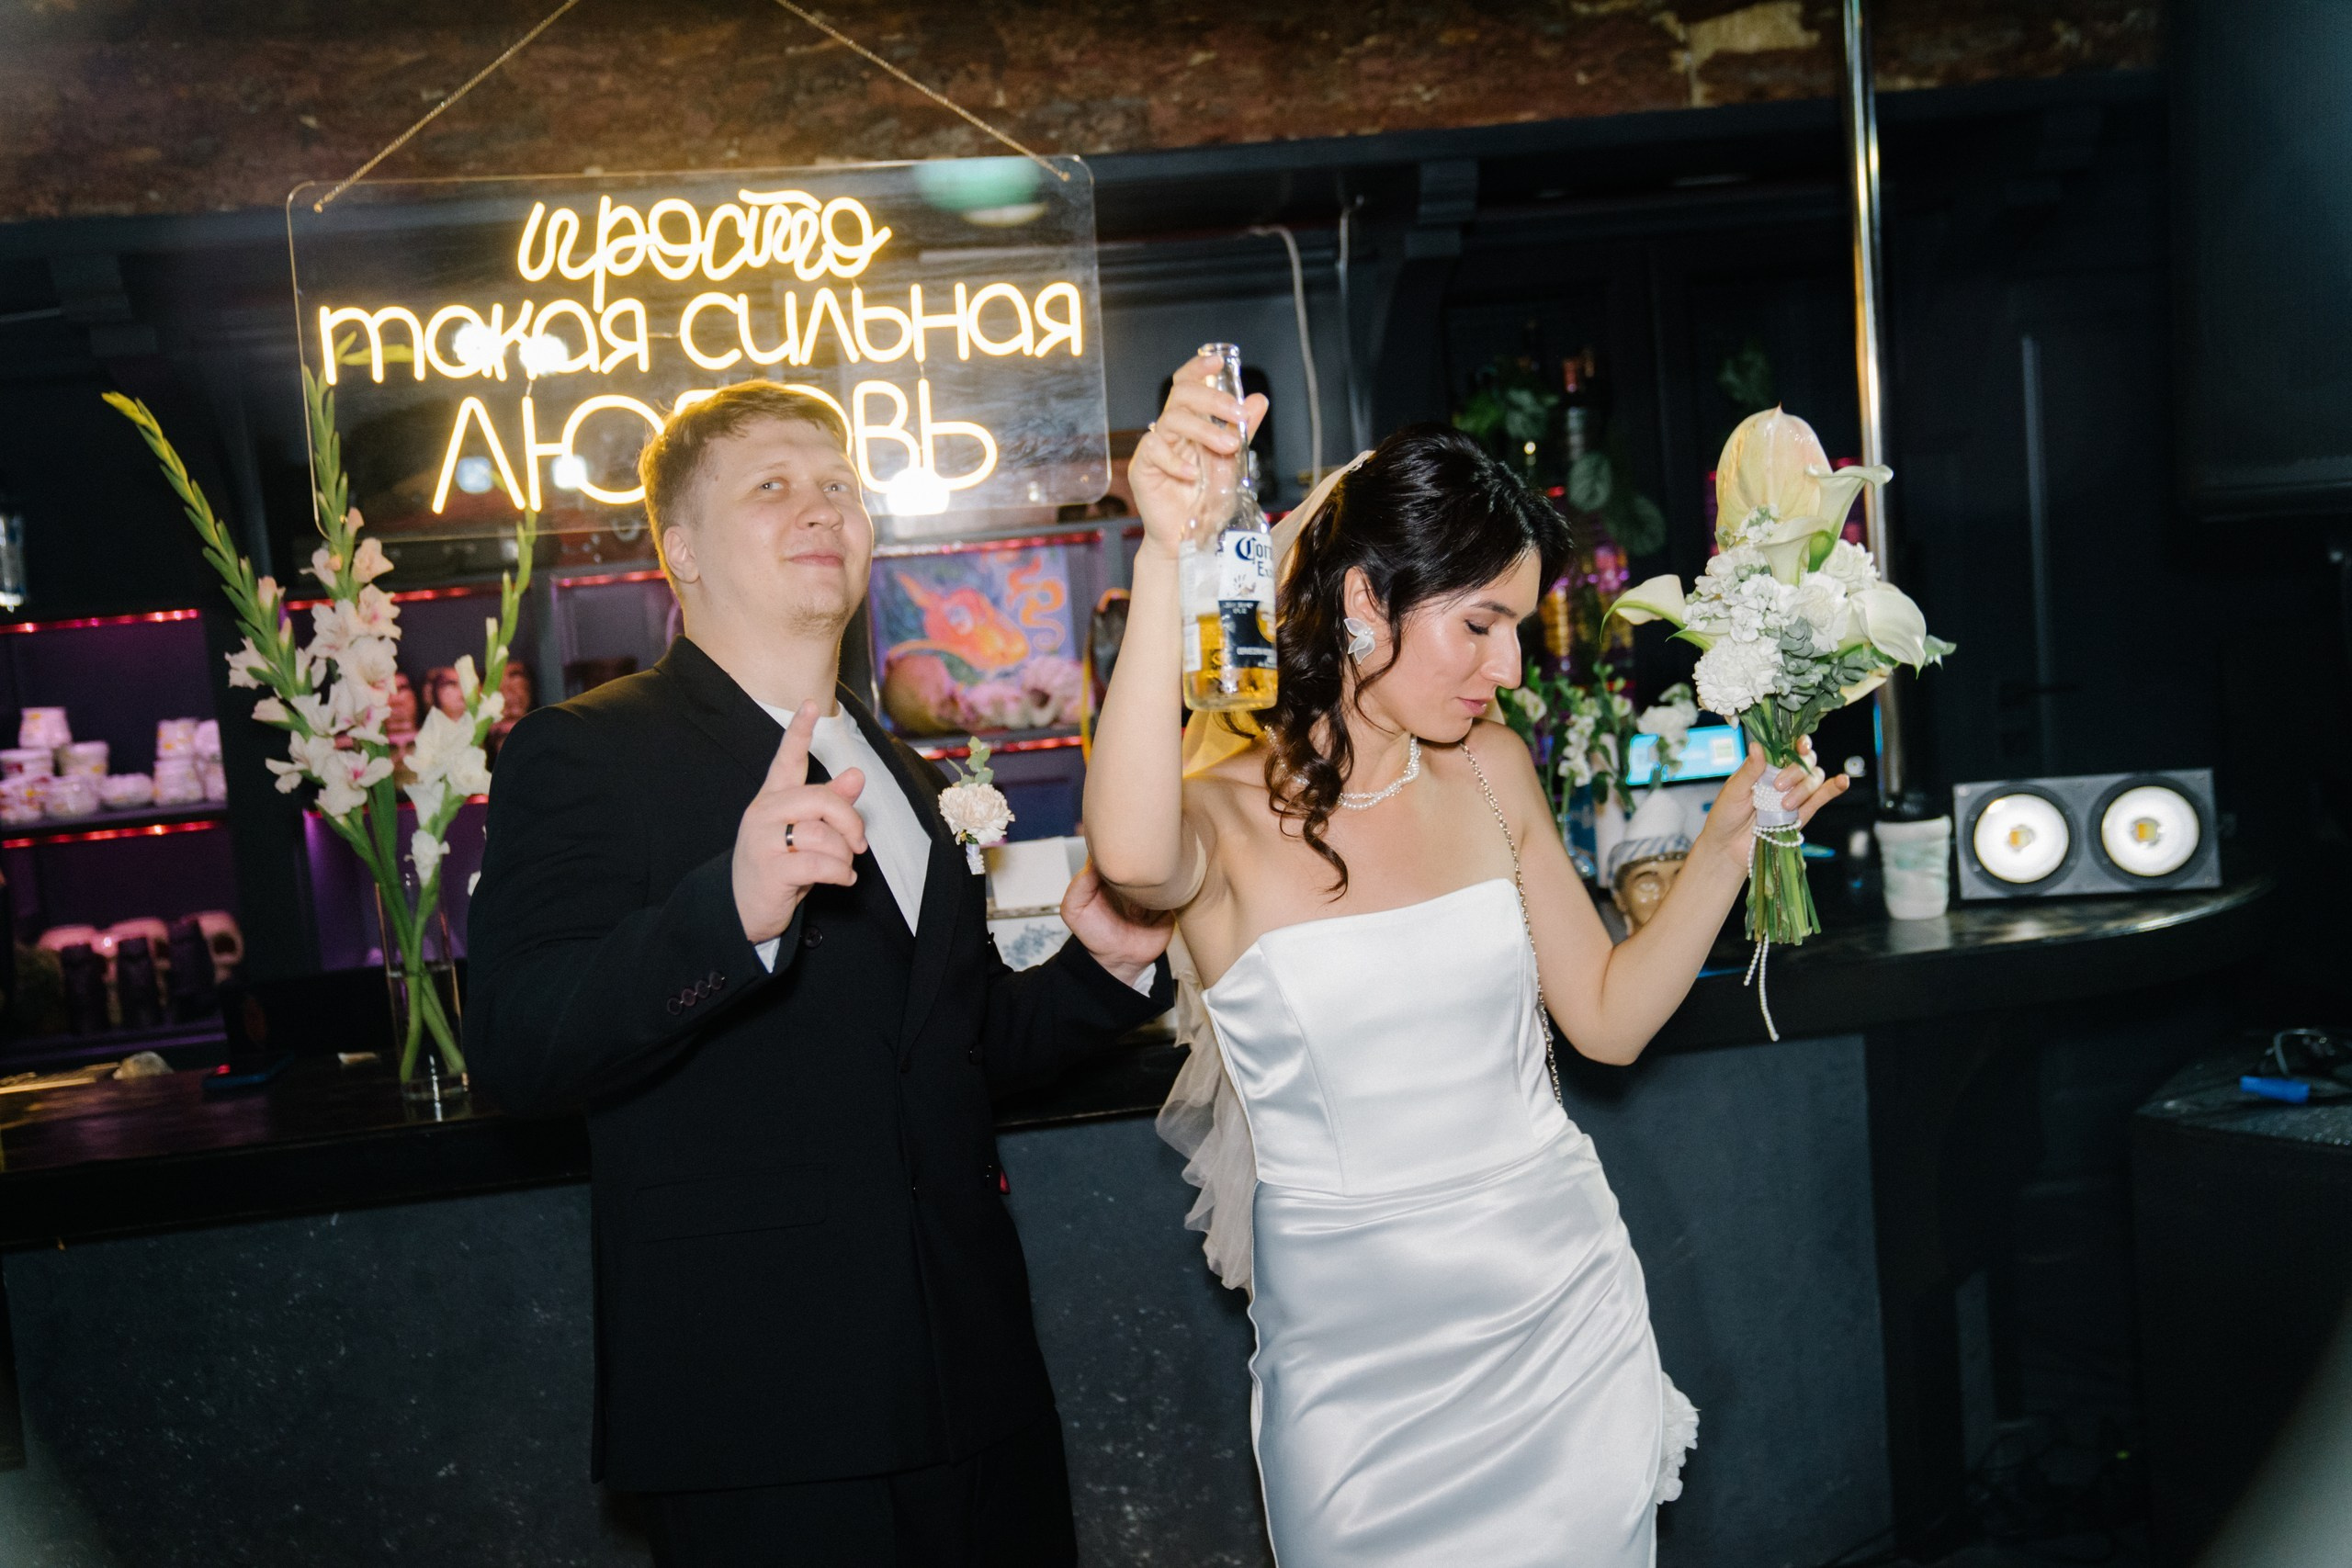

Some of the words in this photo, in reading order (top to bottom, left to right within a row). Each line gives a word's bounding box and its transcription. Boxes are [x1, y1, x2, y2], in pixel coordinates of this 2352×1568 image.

[319, 297, 650, 384] такая
[678, 281, 1083, 371] сильная
[432, 378, 998, 514] ЛЮВЬ
